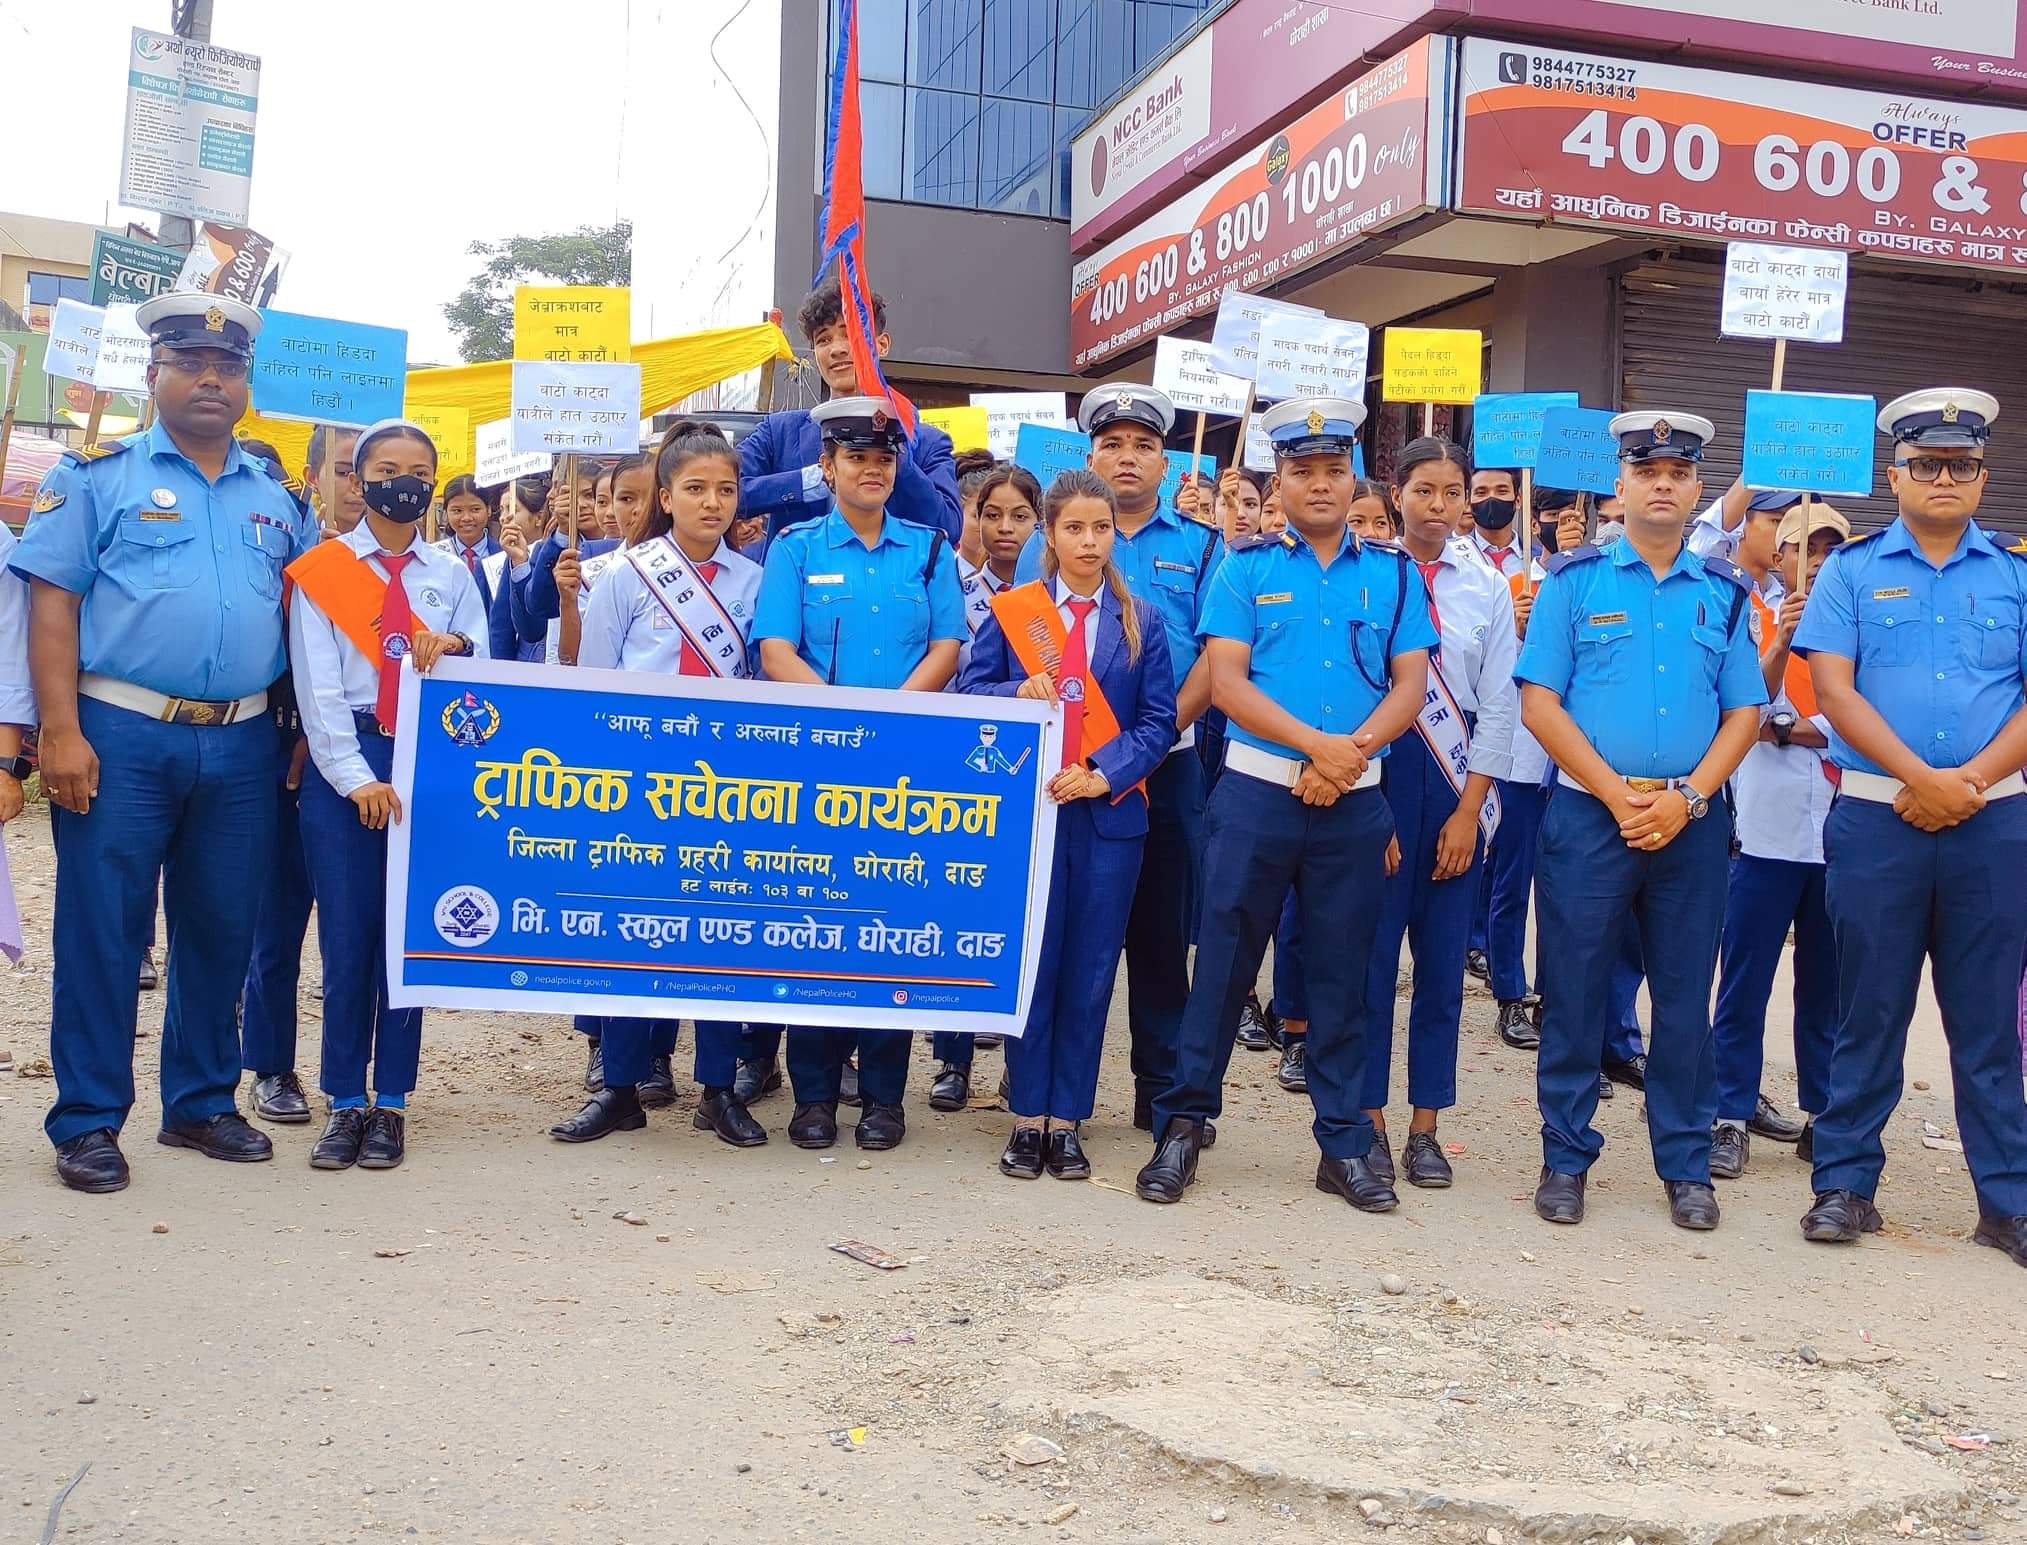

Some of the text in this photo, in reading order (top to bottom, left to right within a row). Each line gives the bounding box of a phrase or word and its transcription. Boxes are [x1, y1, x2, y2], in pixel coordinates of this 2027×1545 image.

[1913, 1, 1943, 16] Ltd.
[1532, 56, 1637, 83] 9844775327
[1931, 55, 1972, 72] Your
[1532, 74, 1637, 101] 9817513414
[1112, 74, 1184, 148] NCC Bank
[1872, 121, 1968, 153] OFFER
[1561, 109, 1721, 183] 400
[1753, 133, 1901, 204] 600
[1931, 154, 1993, 216] &
[1090, 272, 1129, 327] 400
[1135, 243, 1178, 304] 600
[1187, 228, 1208, 276] &
[1215, 190, 1270, 262] 800
[1282, 132, 1367, 225] 1000
[1549, 192, 1652, 221] आधुनिक
[1960, 240, 2007, 262] मात्र
[1929, 215, 2027, 242] GALAXY
[1185, 274, 1218, 297] GALAXY
[1221, 250, 1262, 279] FASHION
[1767, 261, 1808, 281] काट्दा
[1074, 271, 1101, 299] OFFER
[1776, 286, 1832, 306] हेरेर मात्र
[554, 325, 579, 338] मात्र
[1272, 338, 1300, 352] मादक
[307, 363, 333, 382] पनि
[340, 371, 394, 390] लाइनमा
[1168, 389, 1203, 406] पालना
[516, 404, 628, 427] यात्रीले हात उठाएर
[709, 721, 726, 741] र
[472, 746, 1003, 839] ट्राफिक सचेतना कार्यक्रम
[507, 826, 578, 862] जिल्ला
[588, 832, 667, 870] ट्राफिक
[677, 839, 733, 875] प्रहरी
[743, 844, 839, 884] कार्यालय,
[944, 861, 988, 889] दाङ
[680, 878, 701, 894] हट
[821, 886, 850, 901] १००
[615, 911, 692, 950] स्कुल
[698, 914, 757, 948] एण्ड
[955, 930, 1008, 960] दाङ
